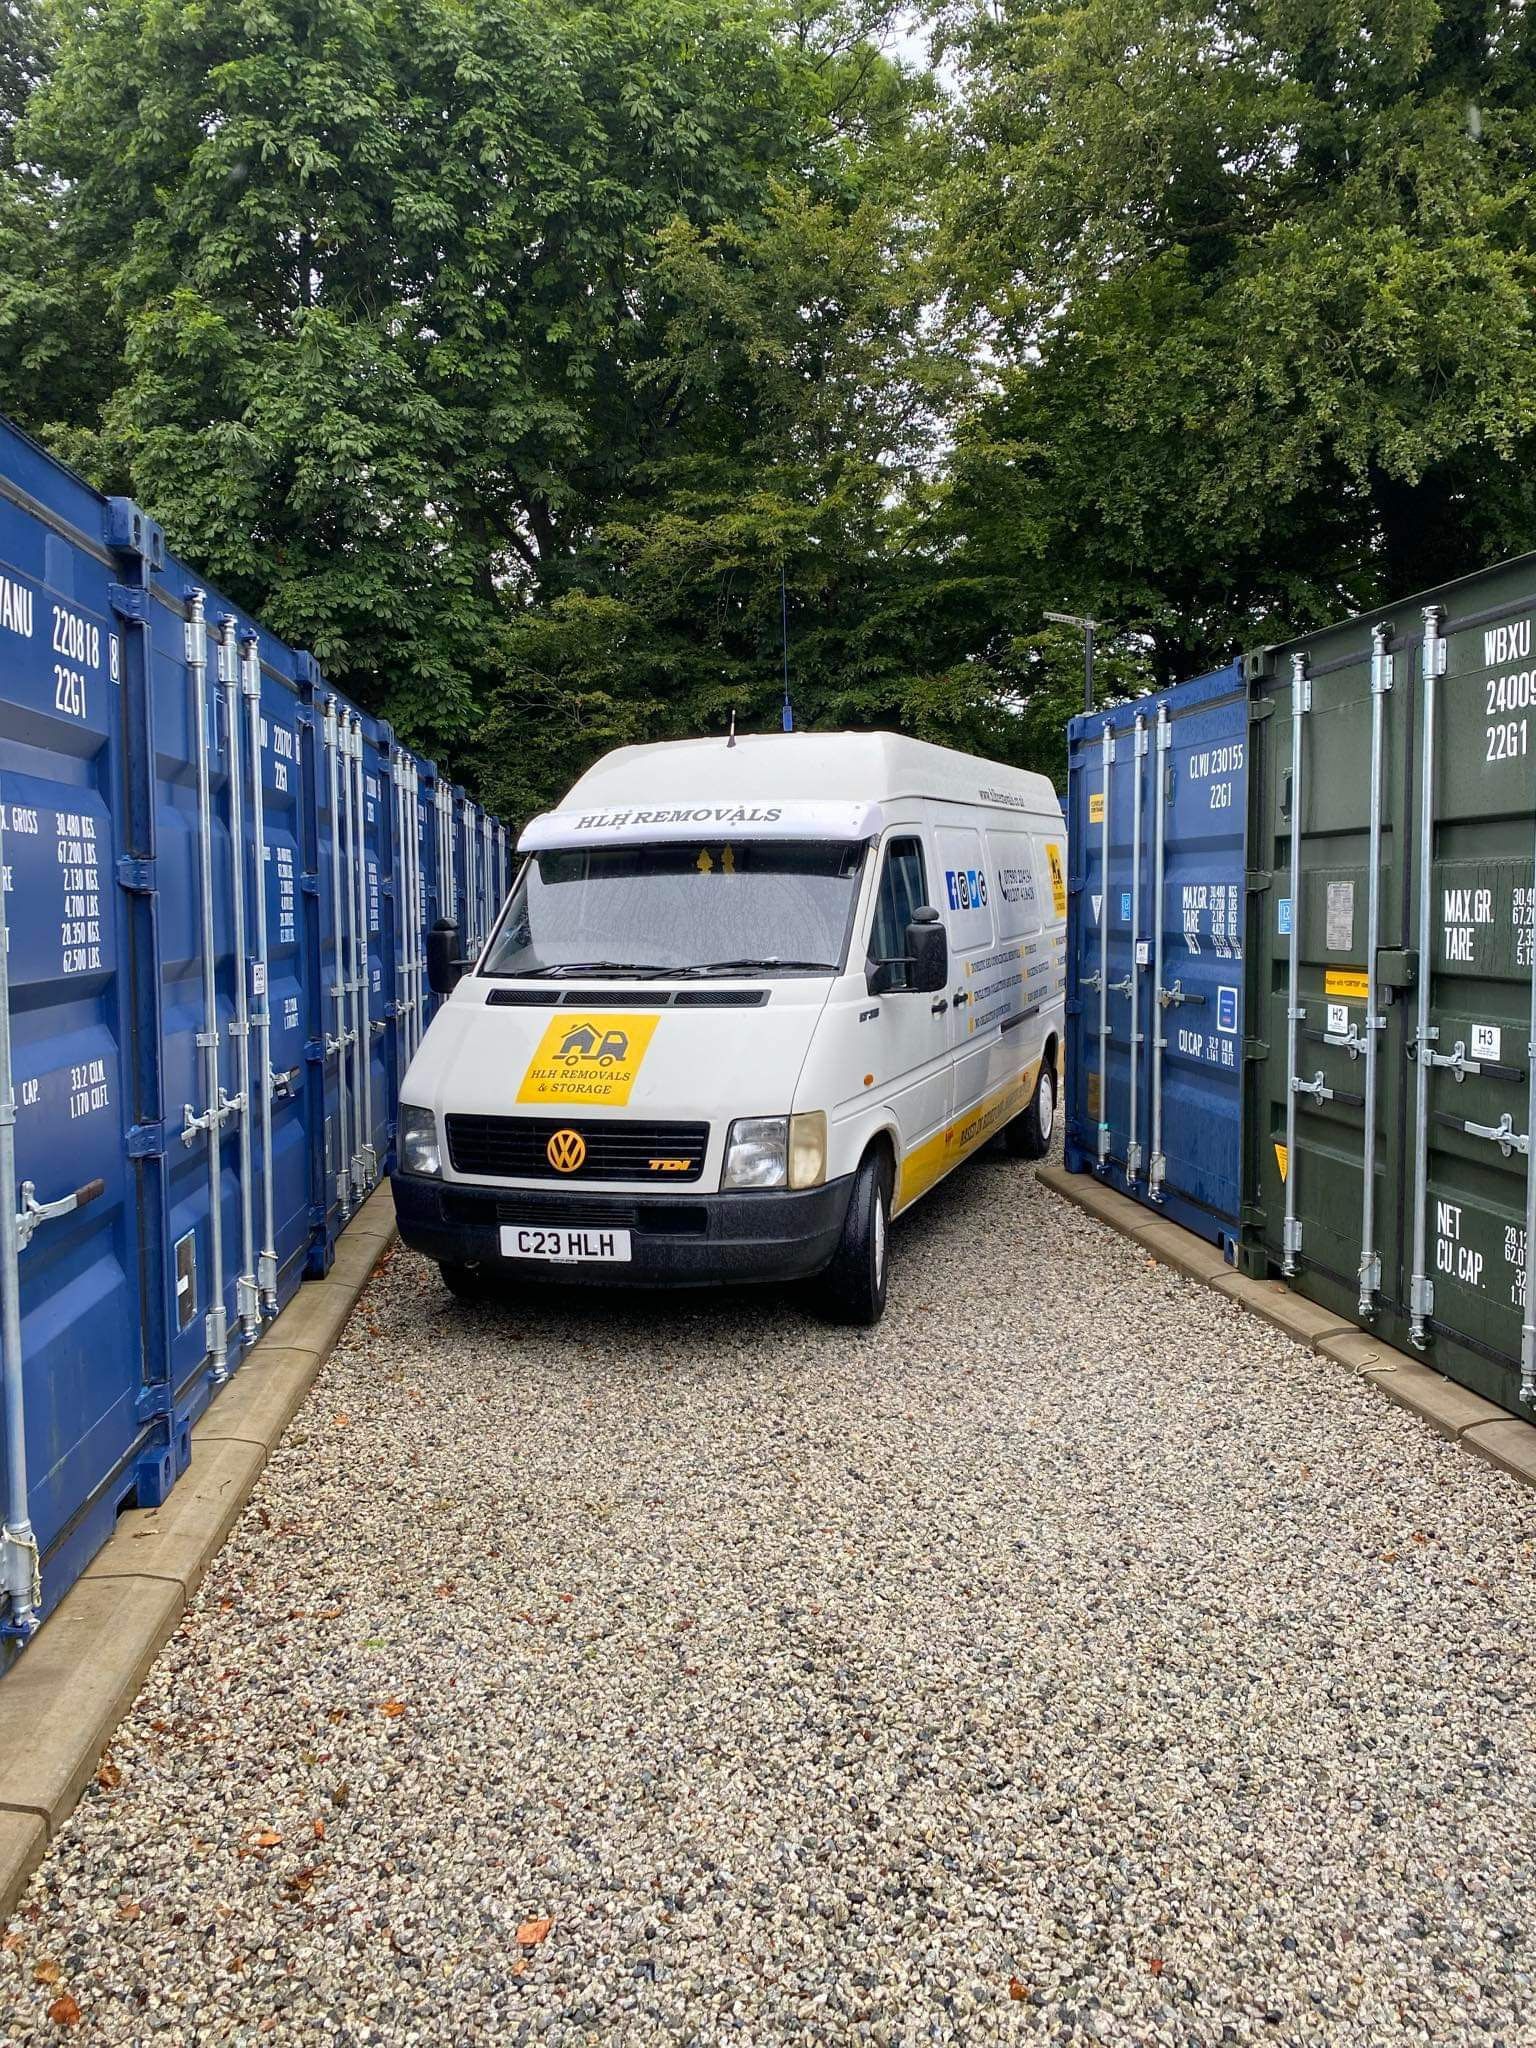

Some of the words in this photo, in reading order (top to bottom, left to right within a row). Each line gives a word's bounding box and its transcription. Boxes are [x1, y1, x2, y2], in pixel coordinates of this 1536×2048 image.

[53, 605, 100, 670] 220818
[110, 637, 119, 680] 8
[1484, 619, 1531, 666] WBXU
[54, 664, 86, 719] 22G1
[1486, 719, 1527, 761] 22G1
[1190, 752, 1210, 779] CLVU
[1211, 744, 1243, 774] 230155
[1210, 782, 1232, 809] 22G1
[12, 806, 39, 834] GROSS
[574, 810, 633, 830] HLH
[631, 808, 783, 826] REMOVALS
[58, 840, 82, 864] 67.200
[63, 868, 84, 891] 2.130
[64, 895, 85, 918] 4.700
[1444, 889, 1495, 923] MAX.GR.
[61, 921, 86, 946] 28.350
[1183, 910, 1200, 933] TARE
[1444, 927, 1475, 962] TARE
[63, 948, 86, 973] 62.500
[1332, 1007, 1343, 1022] H2
[1478, 1028, 1493, 1046] H3
[22, 1078, 41, 1106] CAP.
[70, 1065, 88, 1091] 33.2
[531, 1069, 558, 1079] HLH
[560, 1069, 631, 1082] REMOVALS
[538, 1083, 546, 1093] &
[550, 1083, 612, 1095] STORAGE
[70, 1091, 89, 1119] 1.170
[648, 1160, 691, 1171] TDI
[1437, 1200, 1462, 1240] NET
[518, 1231, 561, 1255] C23
[568, 1233, 614, 1256] HLH
